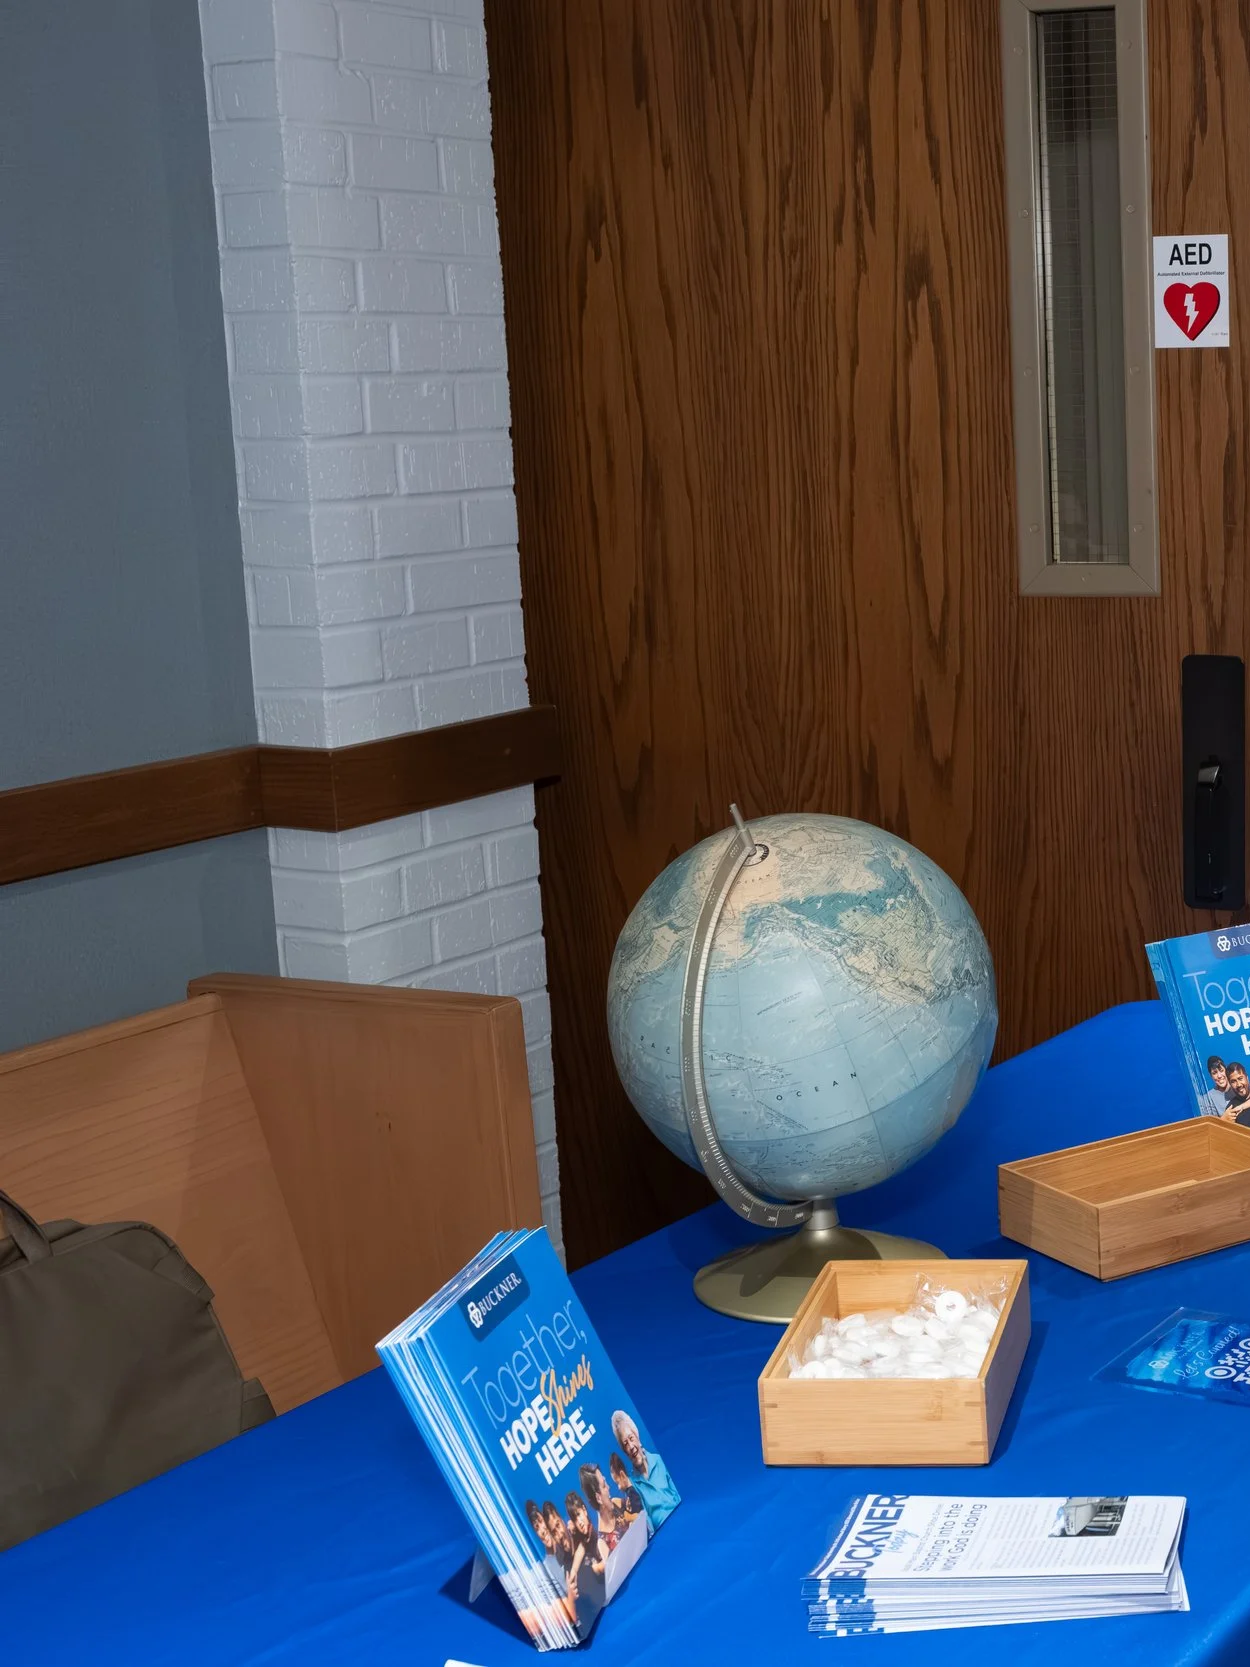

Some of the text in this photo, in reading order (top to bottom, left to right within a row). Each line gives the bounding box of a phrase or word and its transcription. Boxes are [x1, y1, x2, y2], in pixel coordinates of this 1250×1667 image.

[1169, 243, 1212, 266] AED
[479, 1272, 523, 1316] BUCKNER
[461, 1300, 588, 1430] Together,
[500, 1354, 594, 1471] HOPE Shines
[535, 1409, 597, 1485] HERE.
[826, 1495, 910, 1580] BUCKNER
[913, 1503, 964, 1572] Stepping into the
[959, 1528, 974, 1537] is
[964, 1503, 988, 1528] doing
[948, 1537, 970, 1554] God
